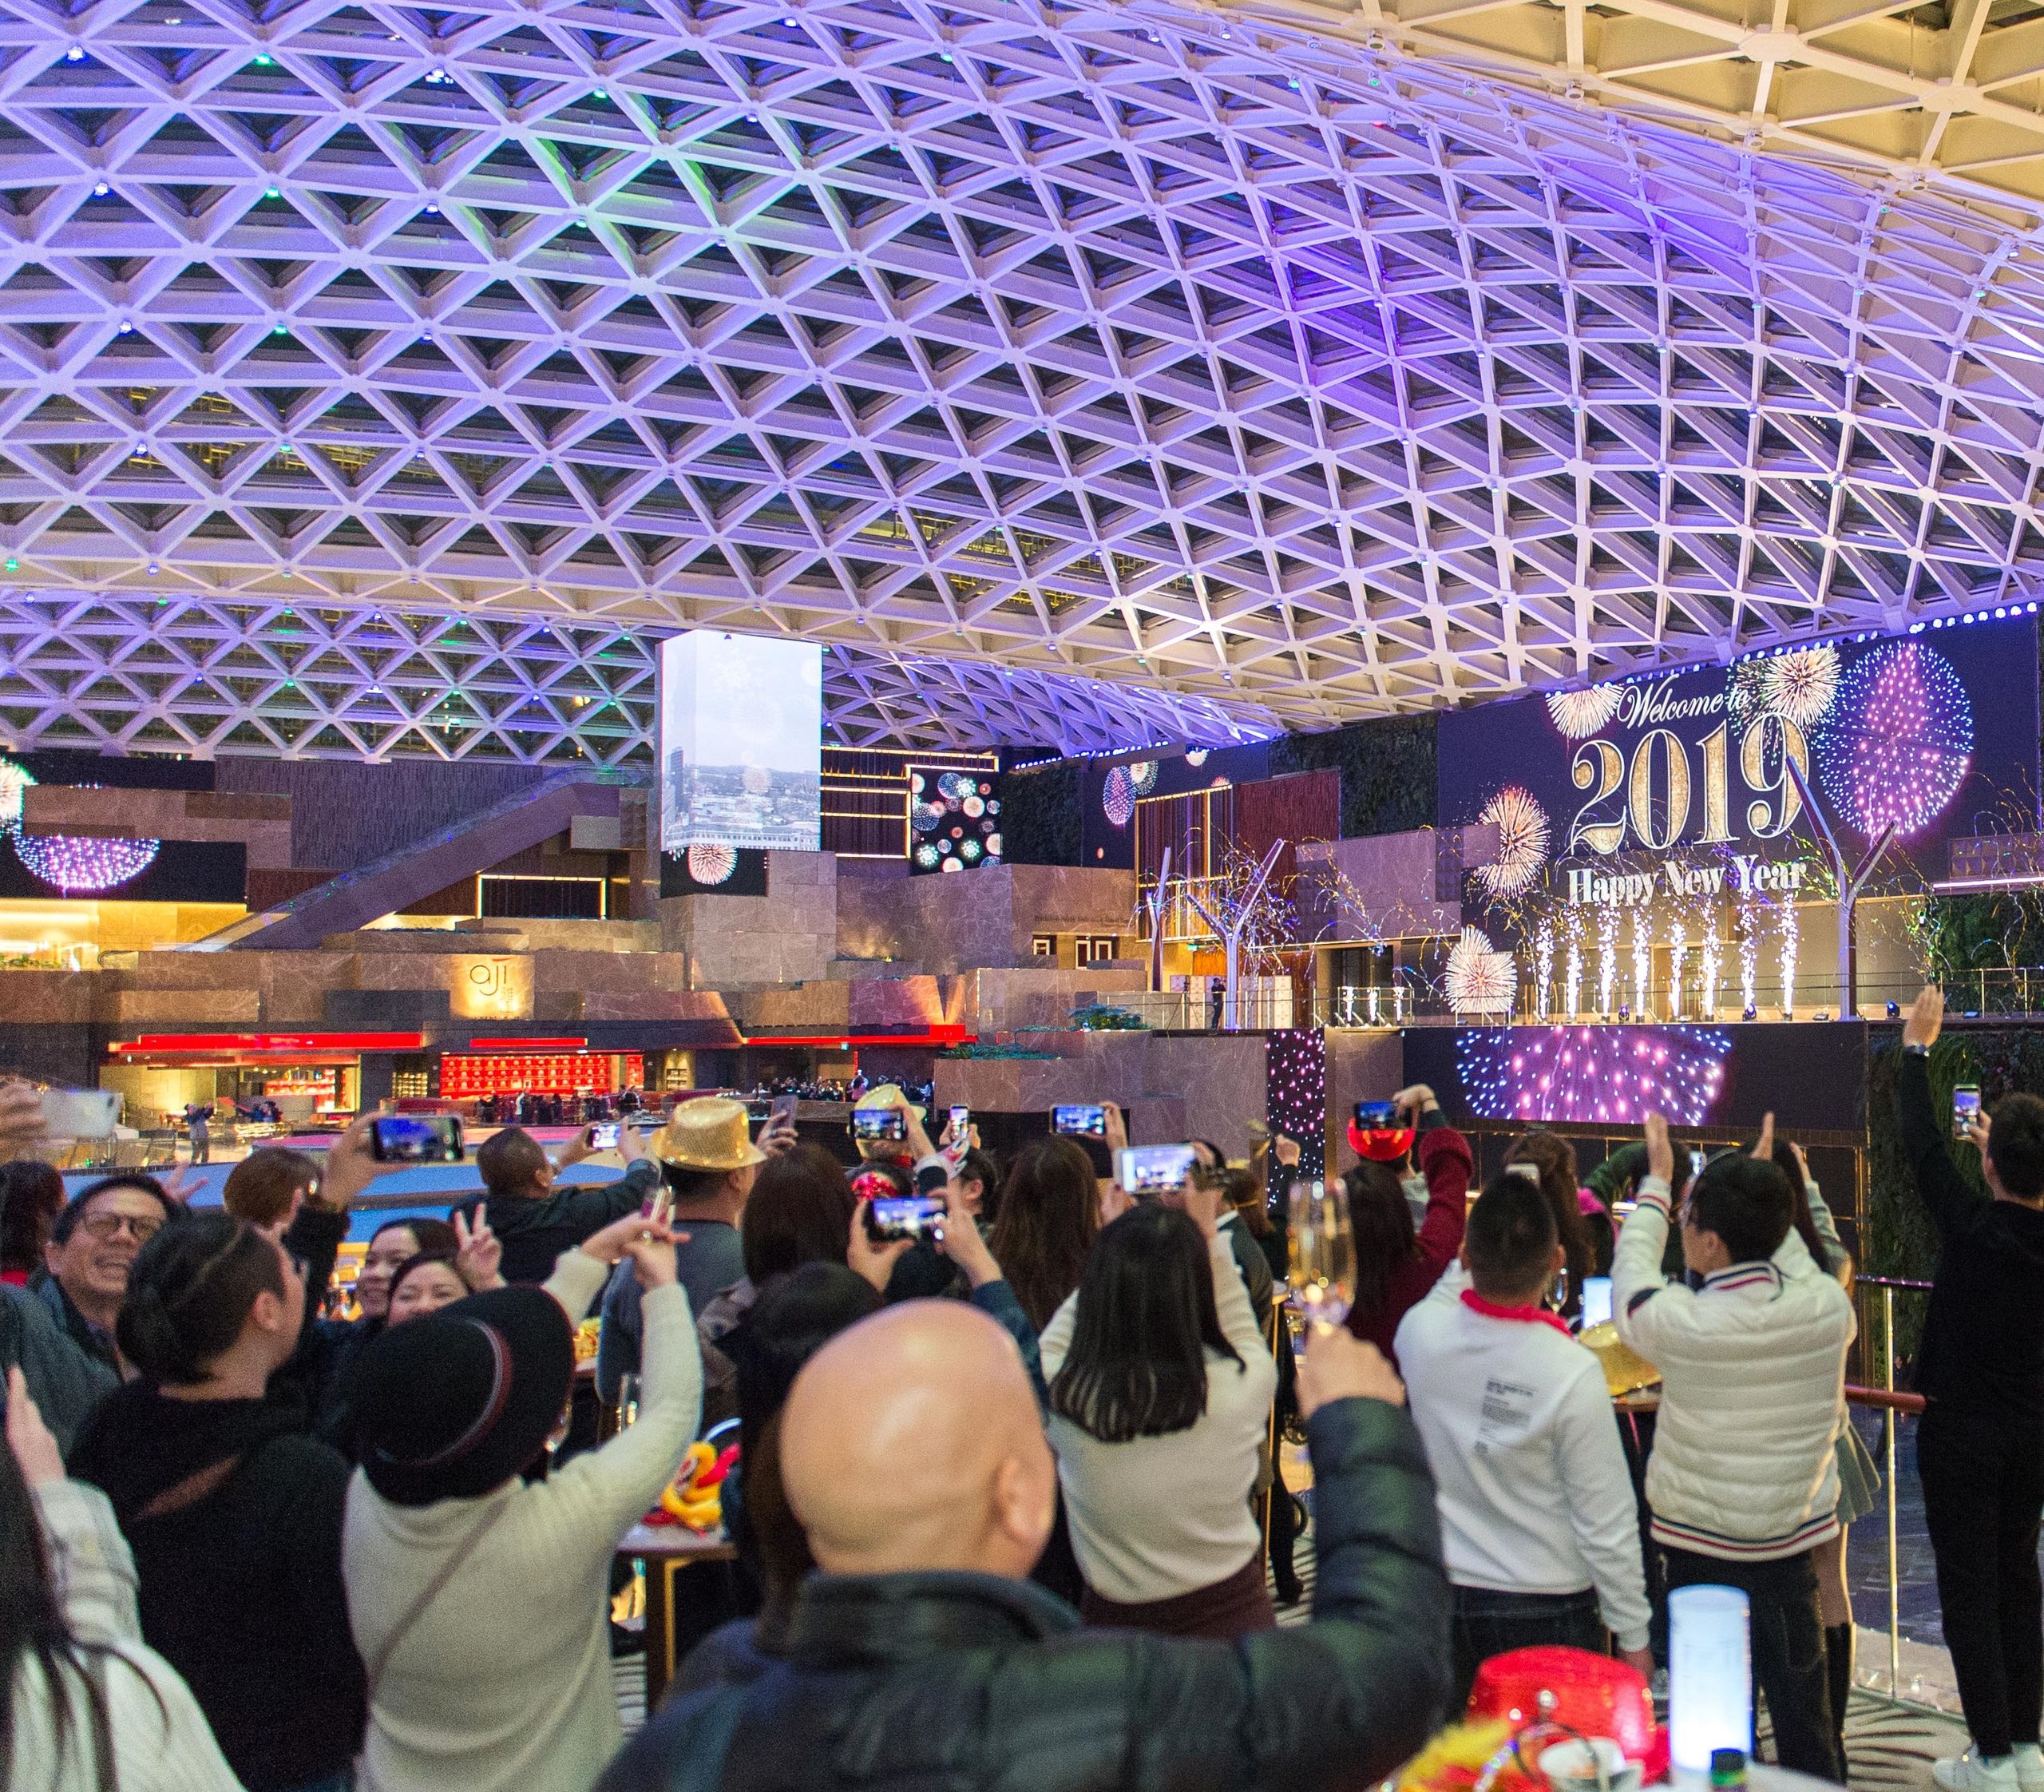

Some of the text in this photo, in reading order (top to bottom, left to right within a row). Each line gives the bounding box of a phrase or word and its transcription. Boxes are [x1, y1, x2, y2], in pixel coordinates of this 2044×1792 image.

[1617, 673, 1751, 730] Welcome to
[1571, 712, 1809, 855] 2019
[1567, 854, 1807, 907] Happy New Year
